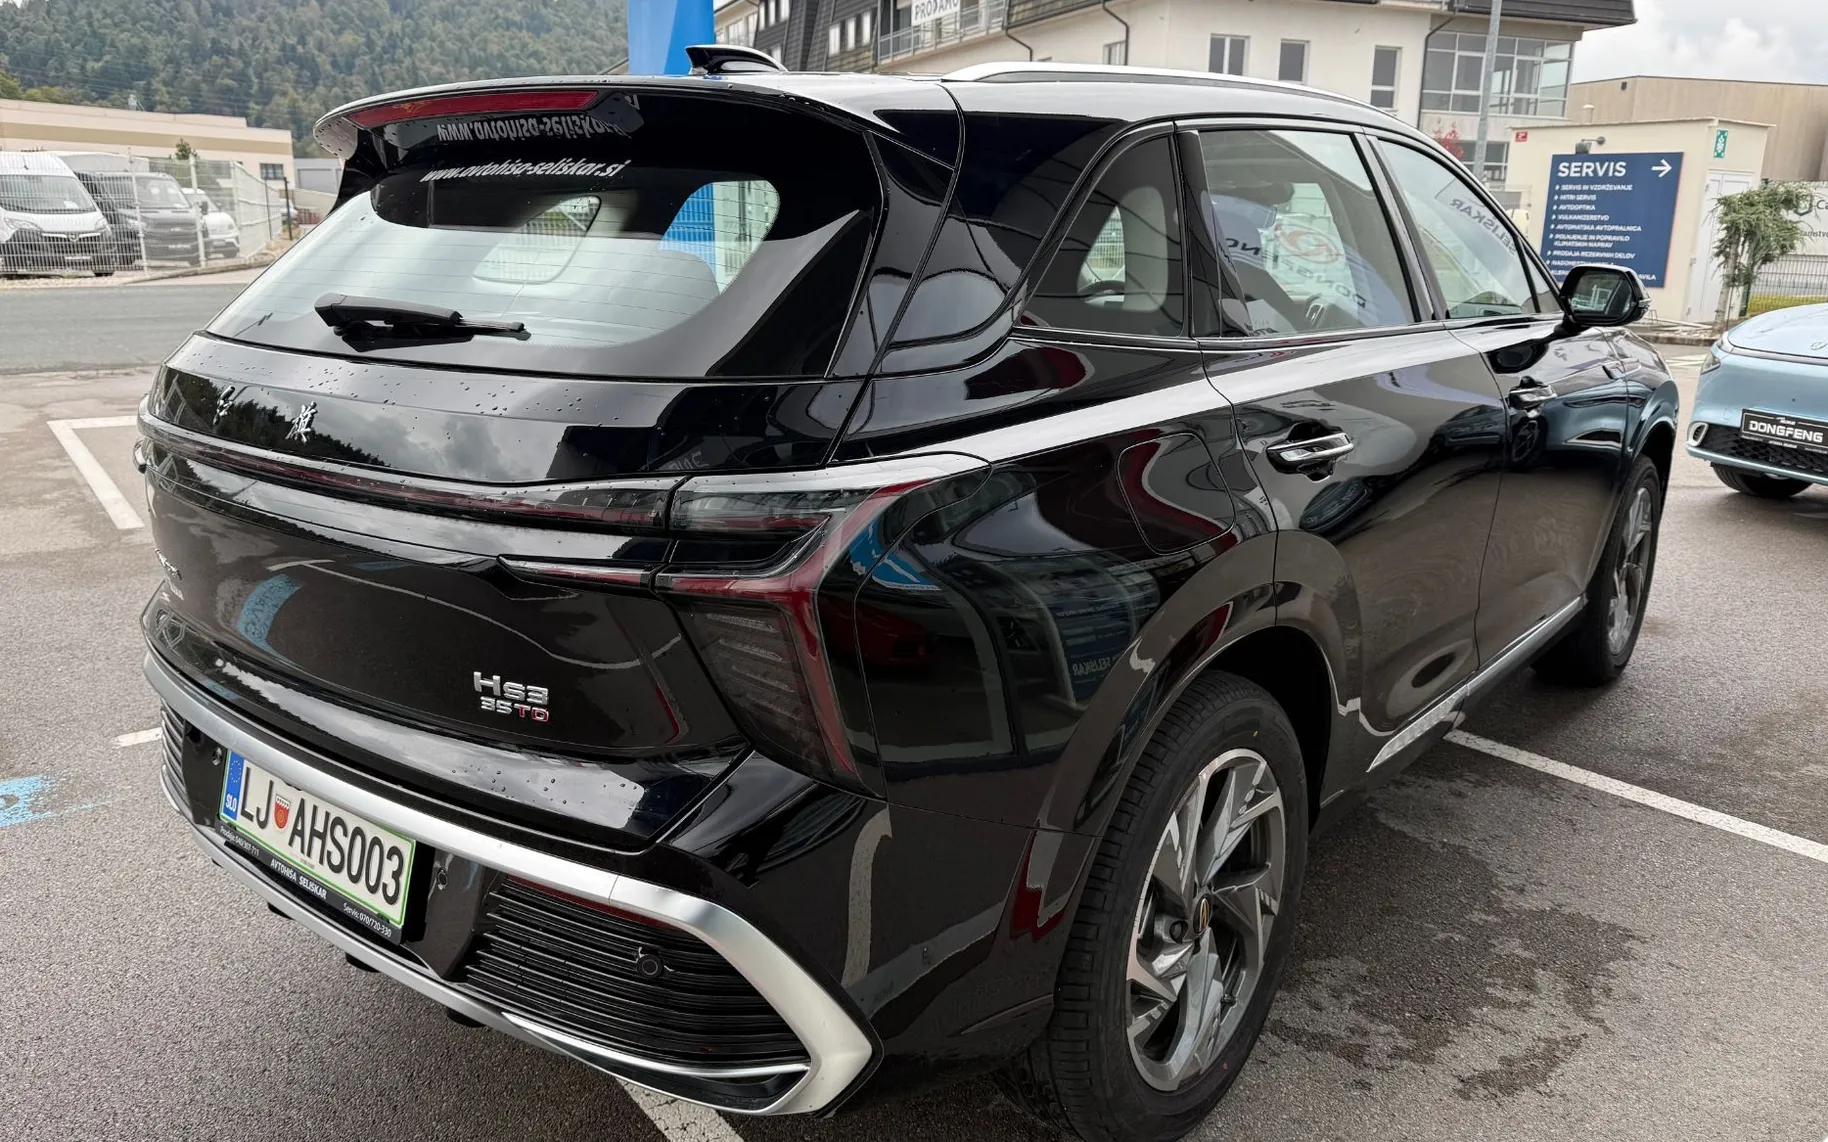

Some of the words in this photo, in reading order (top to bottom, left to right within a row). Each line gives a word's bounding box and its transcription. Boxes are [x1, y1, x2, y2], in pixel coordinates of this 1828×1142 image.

[419, 157, 632, 183] www.avtohisa-seliskar.si
[1557, 161, 1627, 177] SERVIS
[1749, 420, 1824, 443] DONGFENG
[225, 793, 238, 813] SLO
[240, 766, 274, 830] LJ
[288, 797, 404, 906] AHS003
